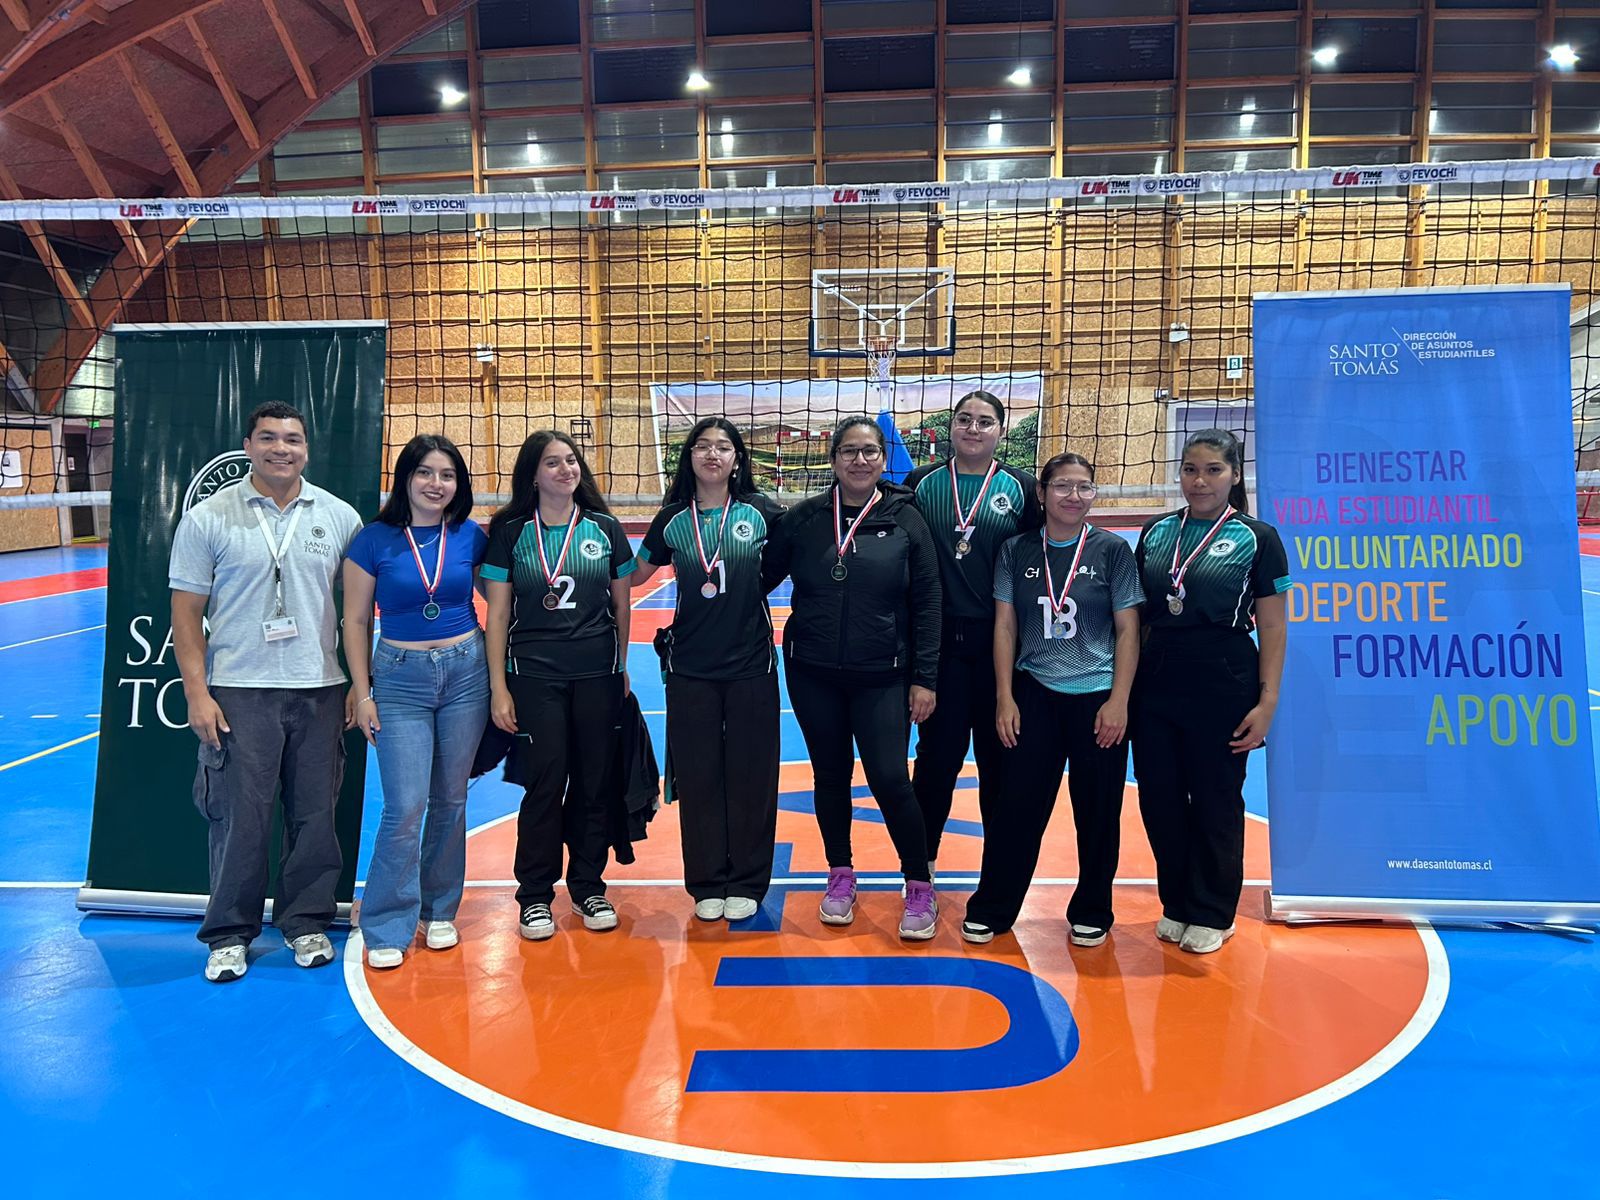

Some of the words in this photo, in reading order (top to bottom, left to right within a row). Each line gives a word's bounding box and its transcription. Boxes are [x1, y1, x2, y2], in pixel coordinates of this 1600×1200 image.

[1332, 171, 1361, 186] UK
[1362, 170, 1383, 178] TIME
[1412, 167, 1458, 179] FEVOCHI
[1081, 181, 1110, 195] UK
[1110, 180, 1131, 188] TIME
[1159, 178, 1201, 189] FEVOCHI
[832, 189, 861, 203] UK
[861, 188, 880, 196] TIME
[908, 186, 950, 197] FEVOCHI
[424, 199, 465, 209] FEVOCHI
[590, 195, 617, 209] UK
[663, 194, 705, 204] FEVOCHI
[119, 204, 144, 217] UK
[188, 203, 229, 212] FEVOCHI
[352, 200, 378, 214] UK
[1403, 330, 1457, 342] DIRECCIÓN
[1329, 343, 1398, 360] SANTO
[1411, 341, 1425, 350] DE
[1426, 340, 1474, 350] ASUNTOS
[1418, 349, 1495, 359] ESTUDIANTILES
[1330, 358, 1399, 376] TOMÁS
[1316, 449, 1467, 484] BIENESTAR
[1273, 496, 1330, 525] VIDA
[1339, 494, 1498, 525] ESTUDIANTIL
[304, 540, 331, 551] SANTO
[1294, 533, 1523, 570] VOLUNTARIADO
[714, 559, 727, 594] 1
[552, 575, 577, 610] 2
[1287, 581, 1448, 623] DEPORTE
[1037, 595, 1078, 640] 18
[1333, 620, 1563, 679] FORMACIÓN
[1426, 693, 1577, 747] APOYO
[1387, 858, 1493, 870] www.daesantotomas.cl
